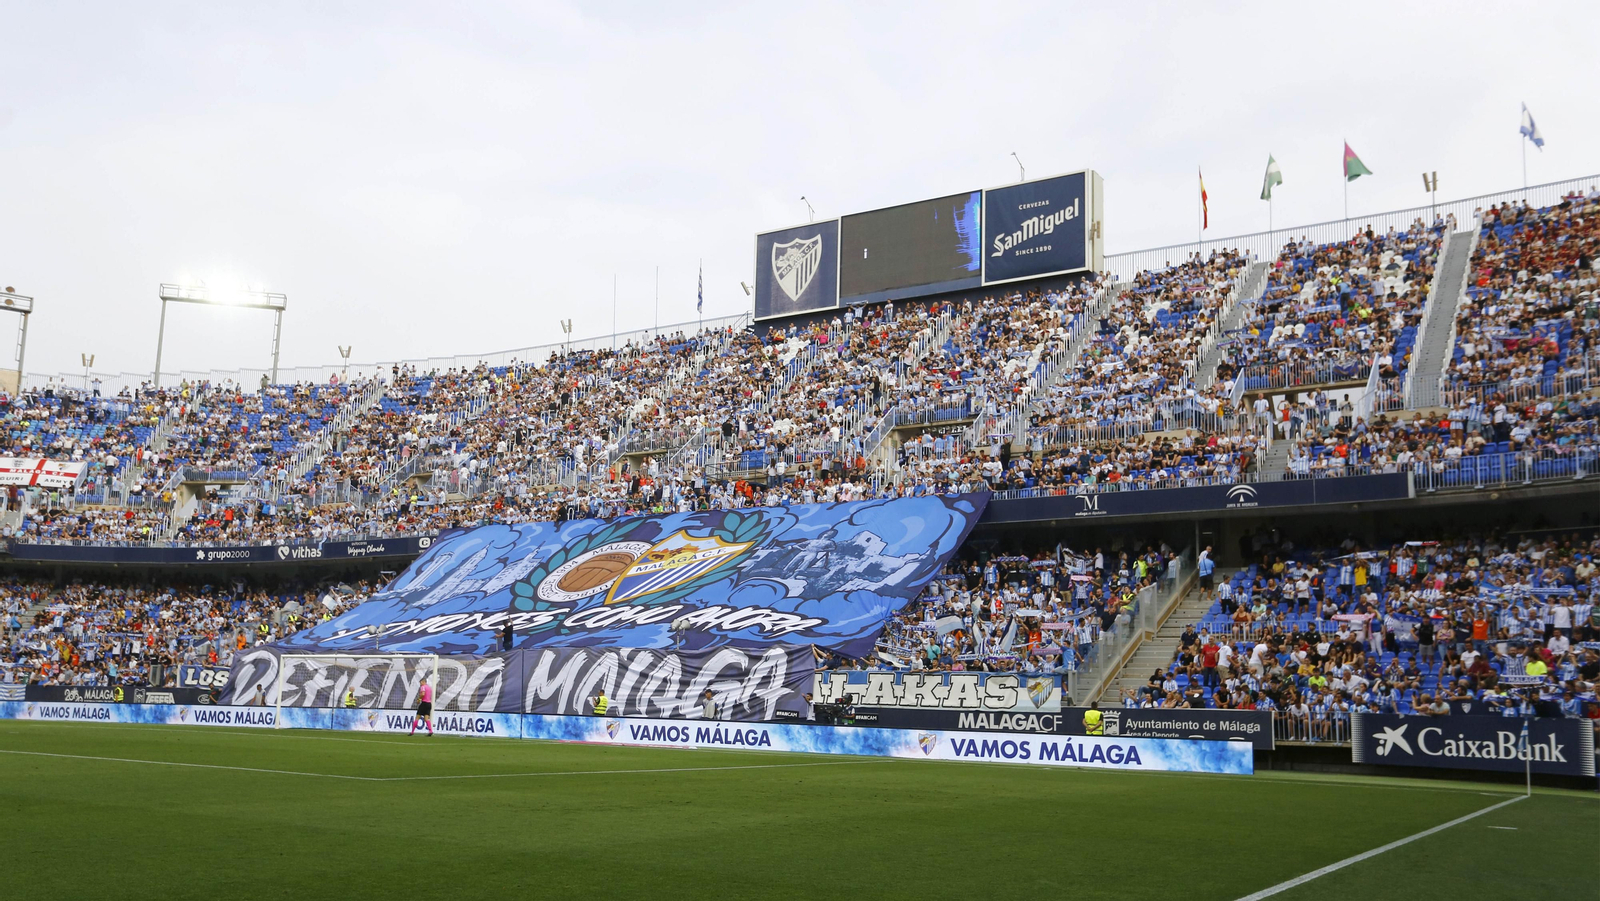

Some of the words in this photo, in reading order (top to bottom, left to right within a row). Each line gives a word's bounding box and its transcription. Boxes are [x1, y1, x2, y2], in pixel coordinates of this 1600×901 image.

[1019, 200, 1050, 210] CERVEZAS
[1015, 248, 1034, 256] SINCE
[1035, 245, 1052, 253] 1890
[9, 468, 47, 476] MALAGA
[208, 550, 250, 560] grupo2000
[291, 547, 322, 559] vithas
[564, 605, 684, 628] COMO
[679, 606, 822, 637] AHORA
[184, 668, 230, 687] LOS
[84, 687, 114, 700] MÁLAGA
[39, 706, 70, 718] VAMOS
[72, 704, 111, 720] MÁLAGA
[194, 709, 232, 724] VAMOS
[436, 713, 495, 733] MÁLAGA
[1125, 718, 1200, 730] Ayuntamiento
[1202, 719, 1217, 730] de
[1219, 720, 1261, 734] Málaga
[630, 724, 691, 743] VAMOS
[695, 723, 772, 747] MÁLAGA
[950, 737, 1031, 760] VAMOS
[1038, 737, 1142, 765] MÁLAGA
[1417, 726, 1568, 763] CaixaBank
